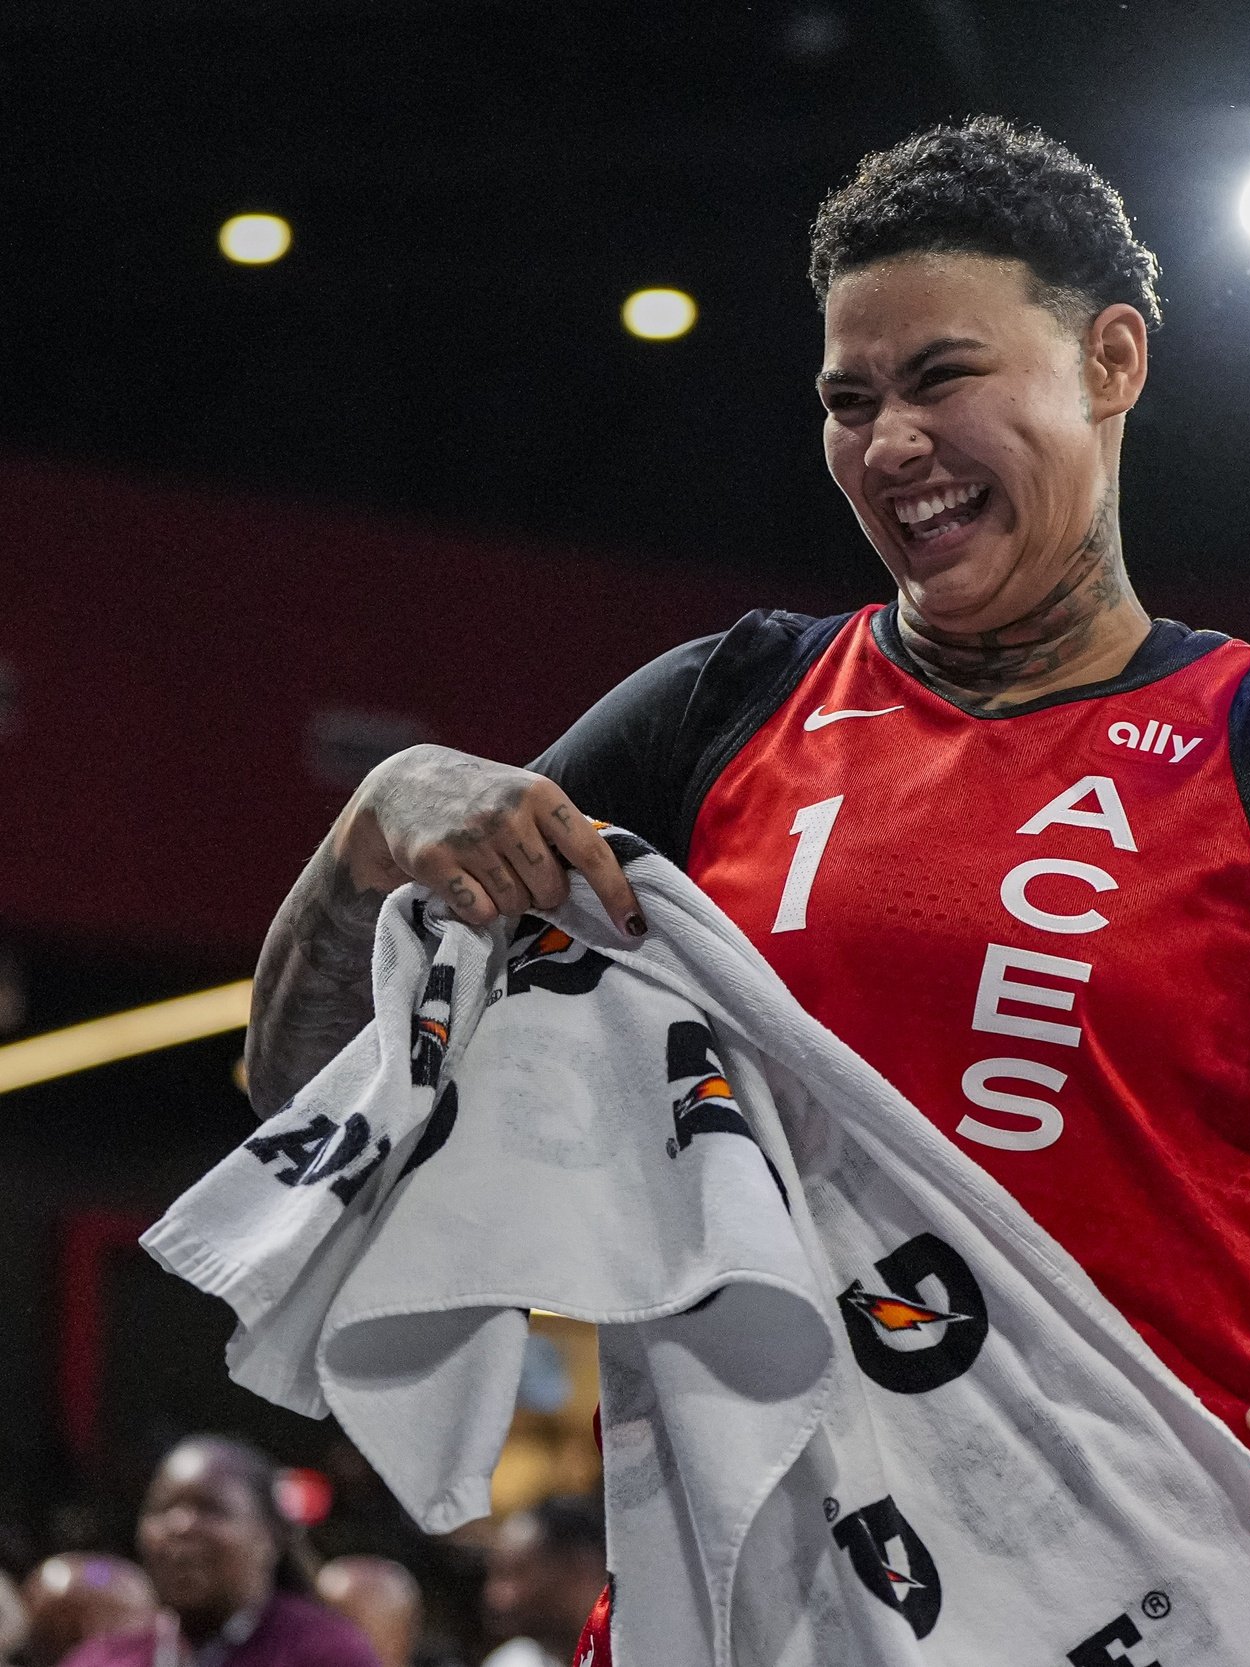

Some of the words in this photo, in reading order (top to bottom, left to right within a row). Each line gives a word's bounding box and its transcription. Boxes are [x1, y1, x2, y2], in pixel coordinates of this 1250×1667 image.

[1107, 719, 1204, 763] ally
[770, 794, 845, 934] 1
[955, 775, 1139, 1151] ACES
